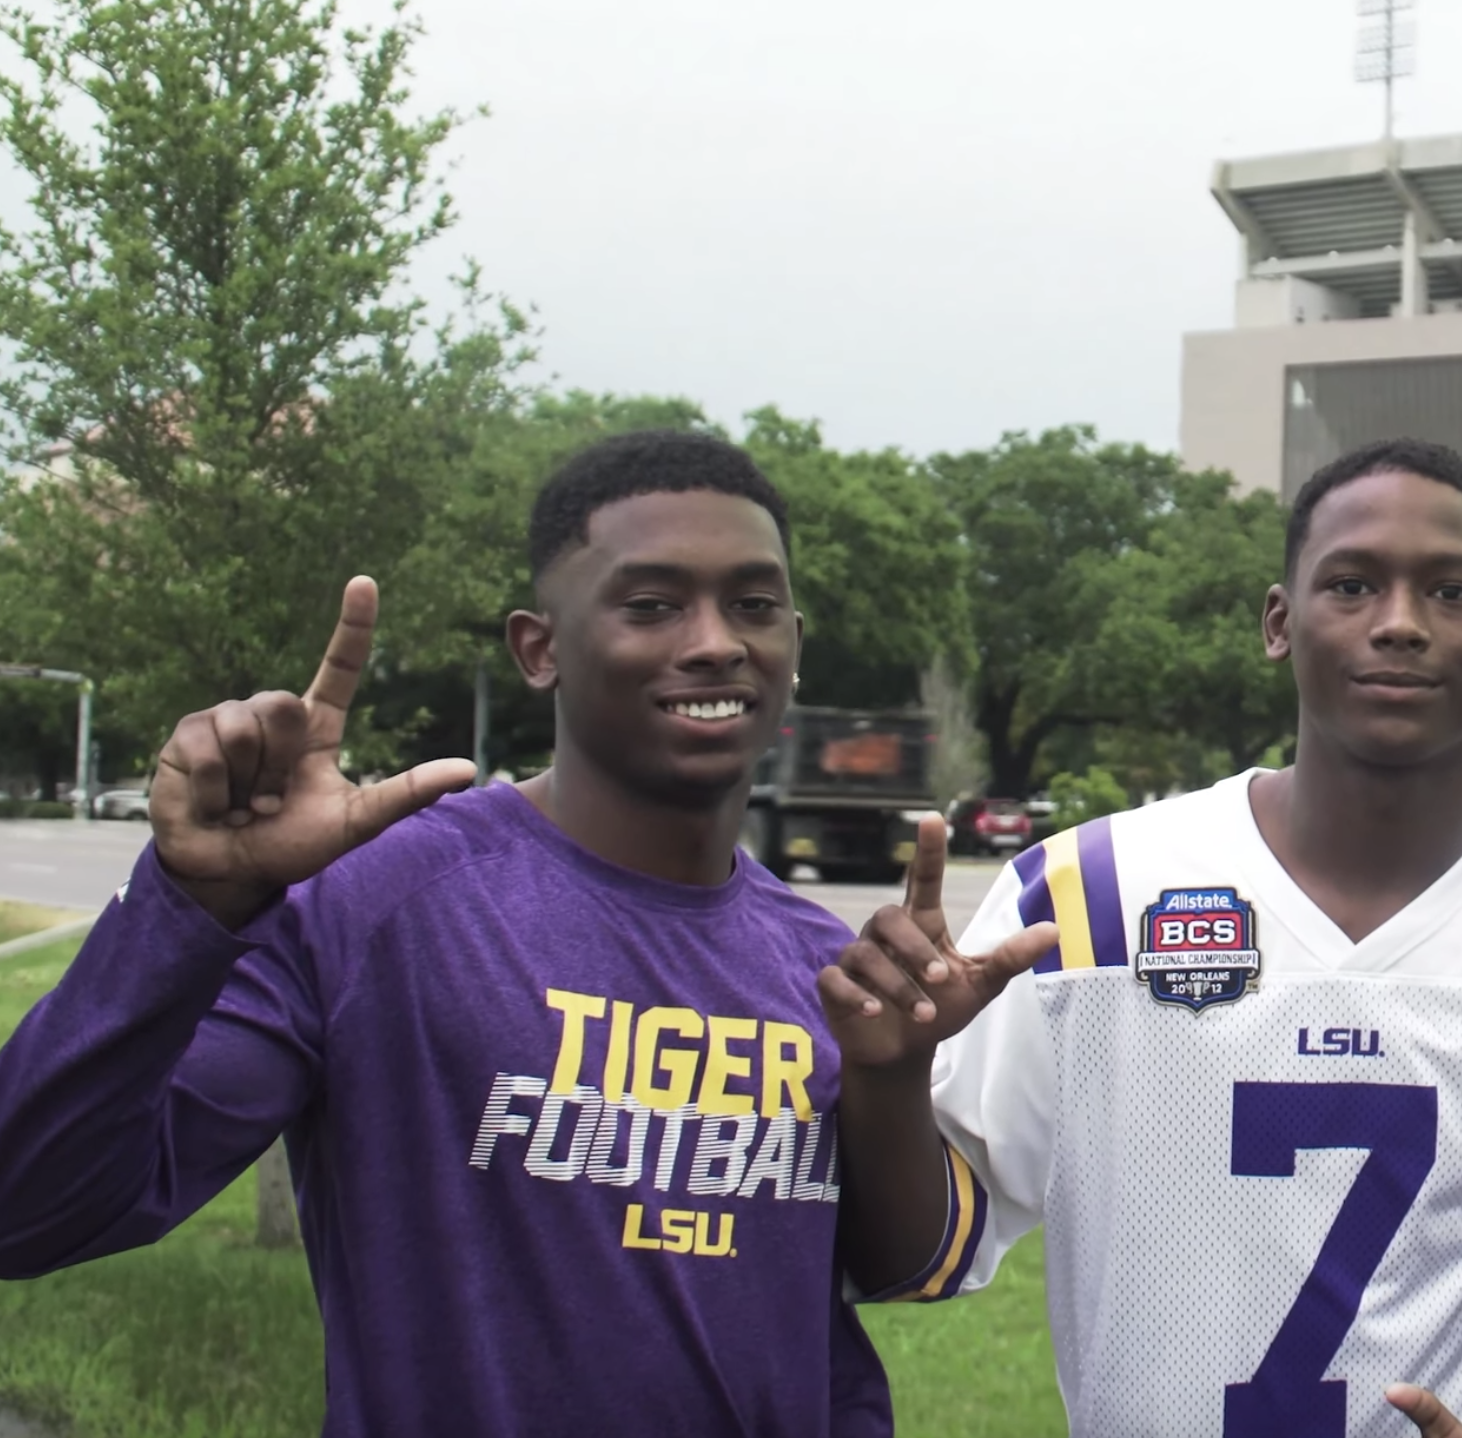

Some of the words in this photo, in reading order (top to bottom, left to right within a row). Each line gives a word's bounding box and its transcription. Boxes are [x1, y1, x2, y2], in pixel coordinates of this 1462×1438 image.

[1160, 919, 1236, 946] BCS
[1145, 953, 1186, 966] NATIONAL
[1188, 952, 1252, 965] CHAMPIONSHIP
[1166, 972, 1186, 982] NEW
[1189, 971, 1230, 981] ORLEANS
[546, 988, 814, 1121] TIGER
[1222, 1081, 1438, 1438] 7
